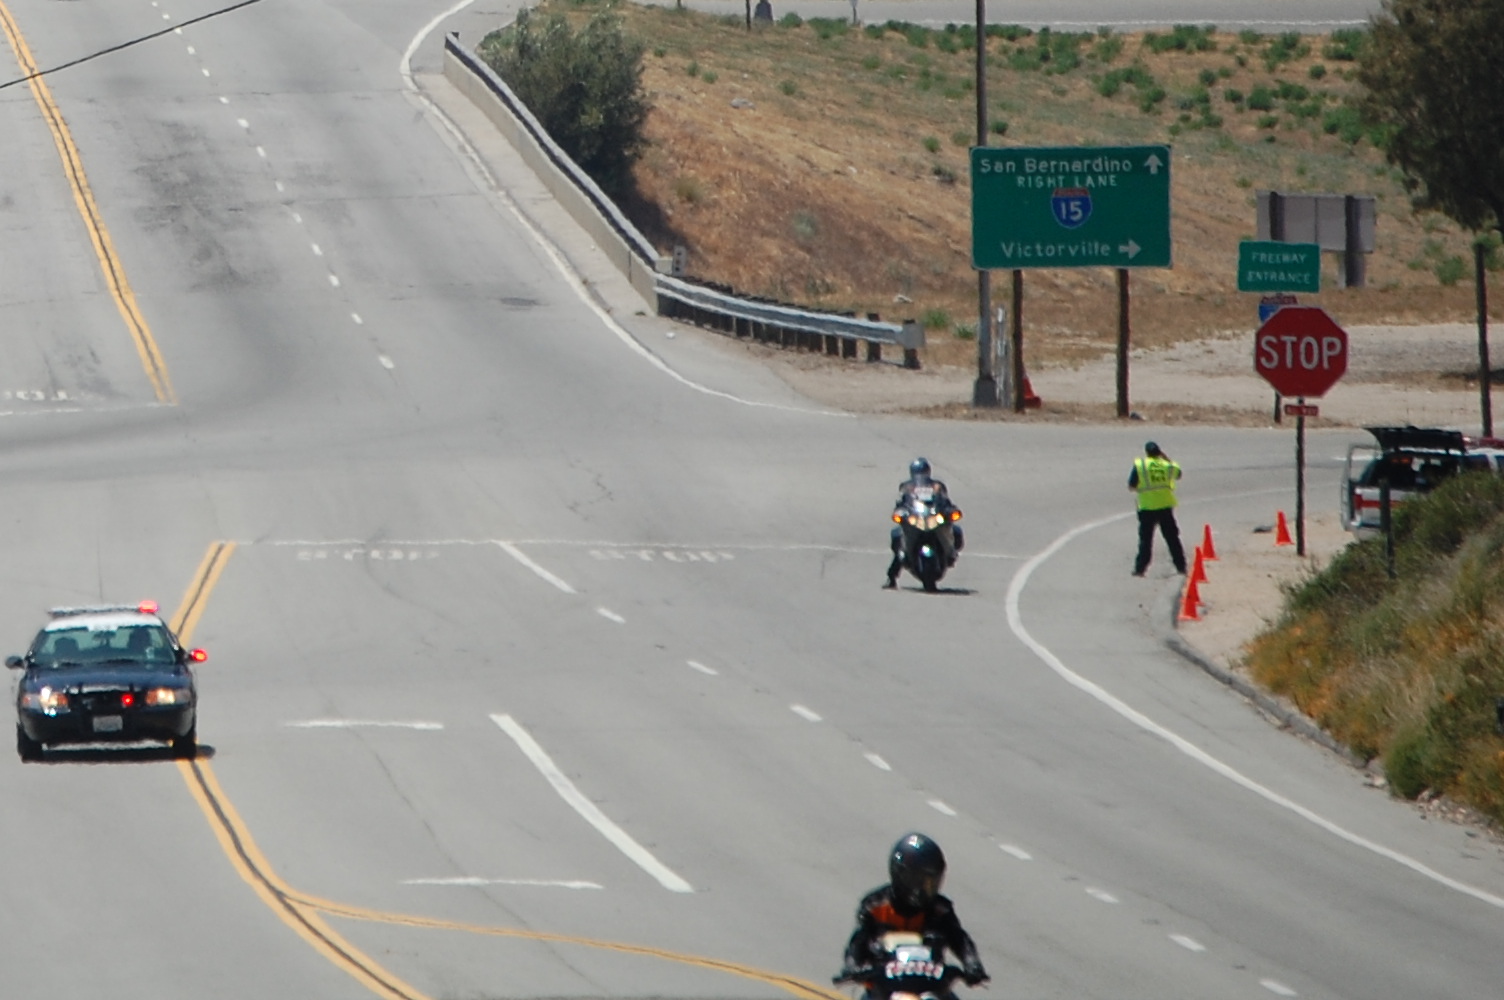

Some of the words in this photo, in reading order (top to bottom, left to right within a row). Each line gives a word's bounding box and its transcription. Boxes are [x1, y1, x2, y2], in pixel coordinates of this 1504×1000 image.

[980, 158, 1016, 173] San
[1024, 156, 1133, 173] Bernardino
[1016, 175, 1065, 188] RIGHT
[1074, 174, 1118, 188] LANE
[1060, 201, 1083, 221] 15
[1001, 241, 1111, 259] Victorville
[1251, 252, 1308, 264] FREEWAY
[1247, 270, 1311, 284] ENTRANCE
[1260, 335, 1342, 370] STOP
